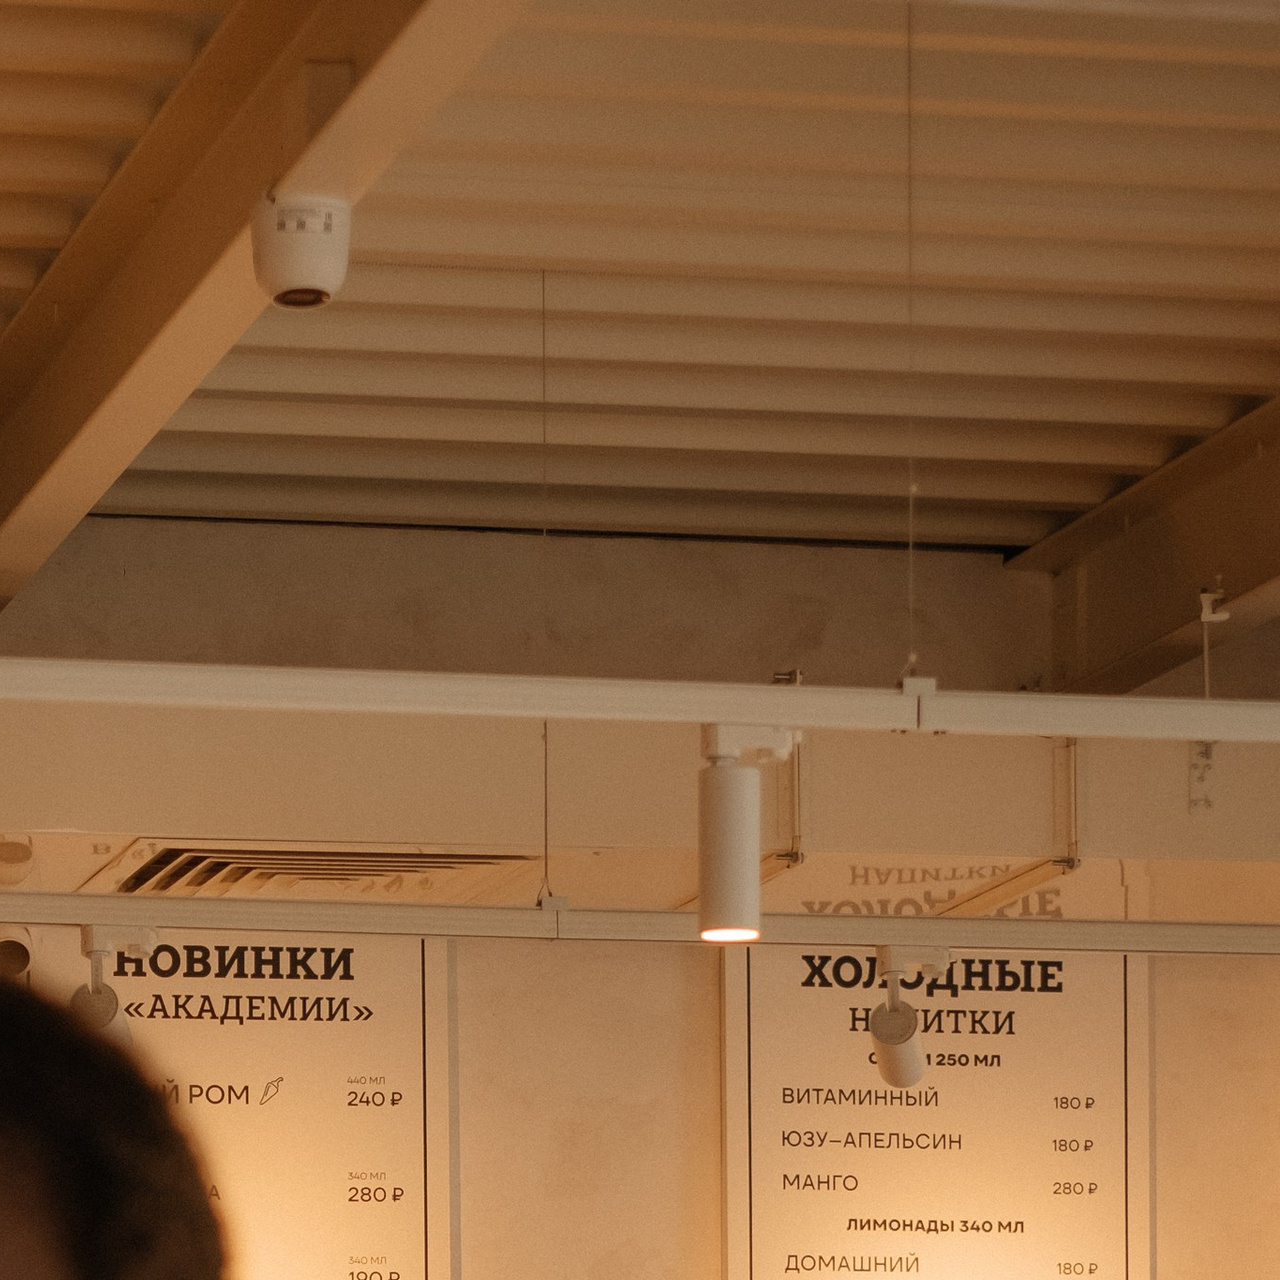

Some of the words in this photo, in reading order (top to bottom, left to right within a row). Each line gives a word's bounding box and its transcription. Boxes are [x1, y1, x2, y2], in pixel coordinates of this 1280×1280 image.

[112, 943, 355, 981] НОВИНКИ
[123, 994, 374, 1026] «АКАДЕМИИ»
[848, 1007, 1016, 1035] НИТКИ
[935, 1053, 970, 1067] 250
[973, 1054, 1001, 1067] МЛ
[189, 1084, 250, 1105] РОМ
[347, 1090, 386, 1107] 240
[390, 1091, 403, 1107] ₽
[782, 1086, 939, 1107] ВИТАМИННЫЙ
[1053, 1096, 1082, 1110] 180
[1084, 1096, 1096, 1110] ₽
[1052, 1138, 1080, 1153] 180
[1083, 1139, 1094, 1152] ₽
[782, 1173, 859, 1192] МАНГО
[1052, 1181, 1085, 1196] 280
[1087, 1182, 1099, 1195] ₽
[347, 1186, 387, 1203] 280
[391, 1187, 405, 1203] ₽
[846, 1218, 955, 1235] ЛИМОНАДЫ
[959, 1220, 994, 1233] 340
[997, 1220, 1025, 1234] МЛ
[784, 1252, 919, 1274] ДОМАШНИЙ
[1056, 1262, 1085, 1276] 180
[1088, 1262, 1099, 1276] ₽
